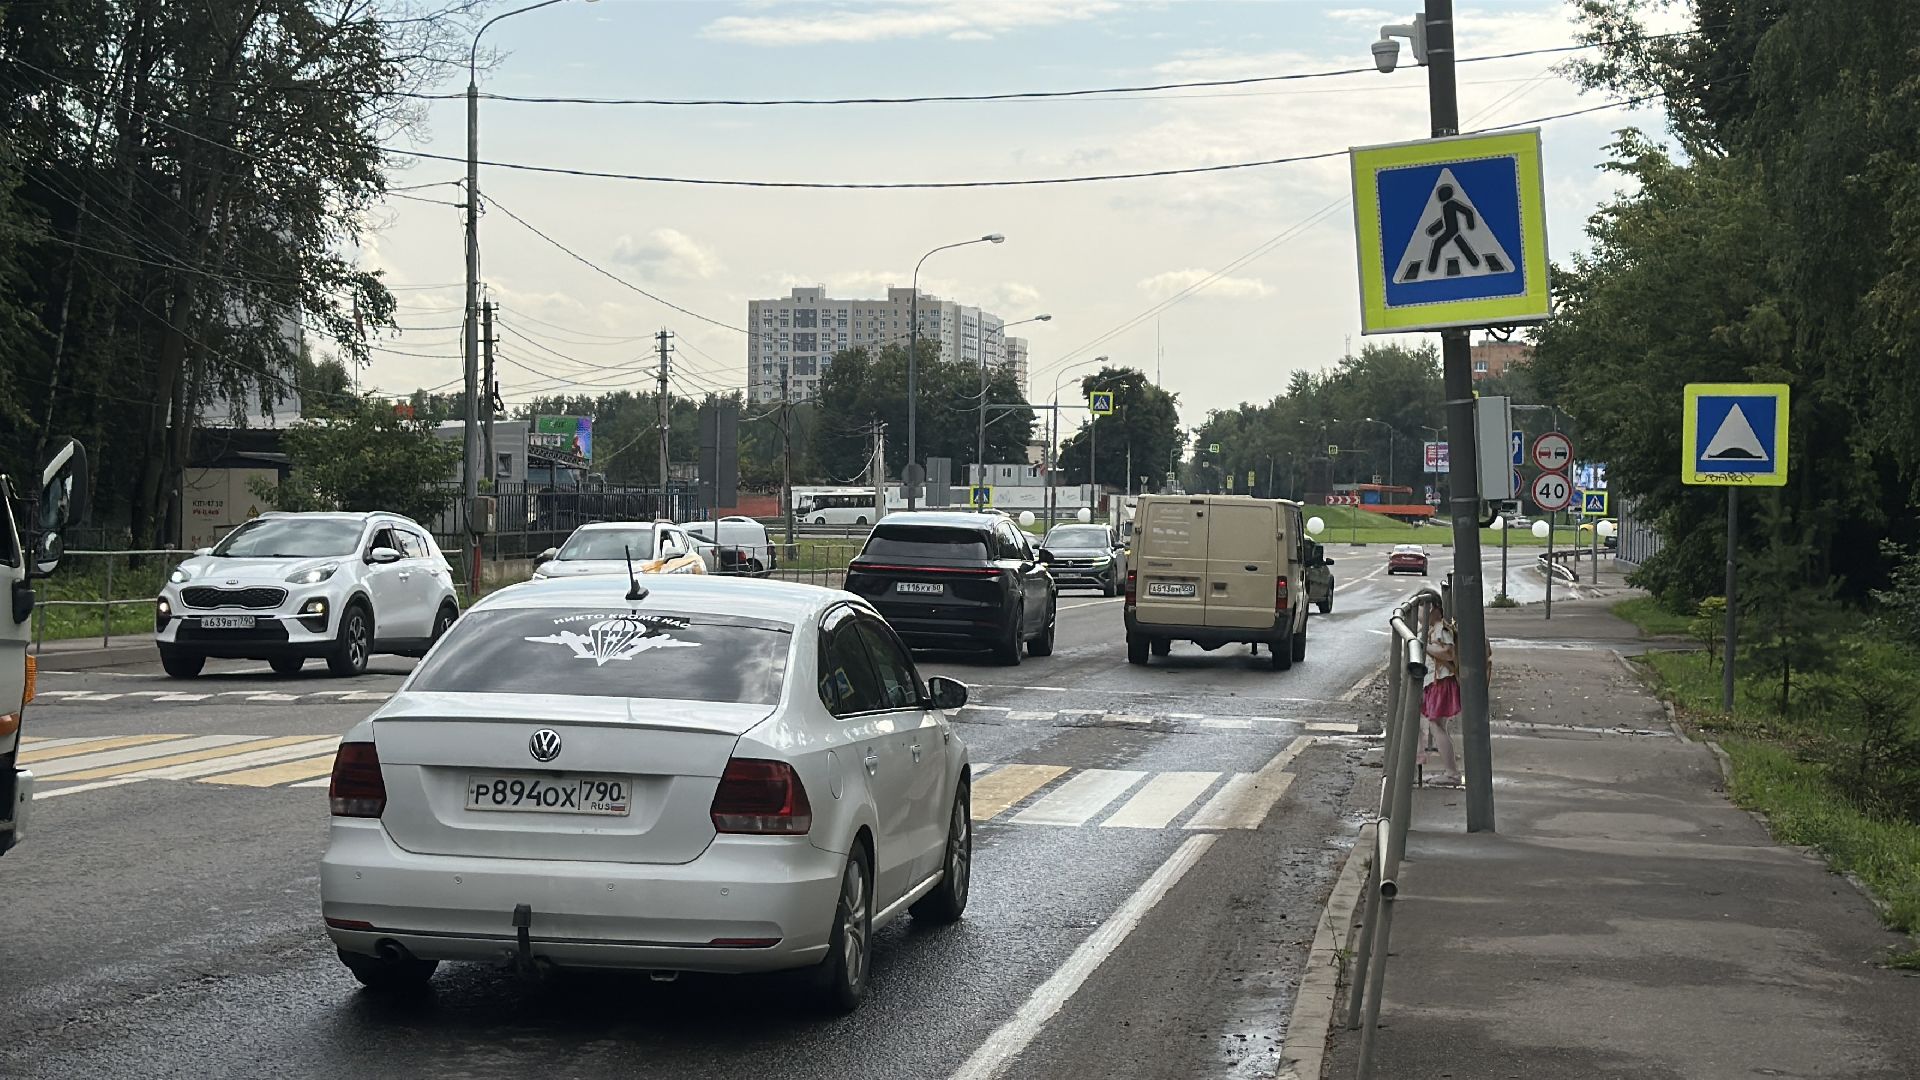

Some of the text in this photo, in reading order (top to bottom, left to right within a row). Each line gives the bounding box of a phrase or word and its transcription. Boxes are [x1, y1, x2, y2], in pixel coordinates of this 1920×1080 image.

[1539, 483, 1565, 499] 40
[553, 613, 605, 625] НИКТО
[608, 613, 660, 623] КРОМЕ
[475, 779, 622, 808] Р894ОХ 790
[590, 801, 612, 811] RUS
